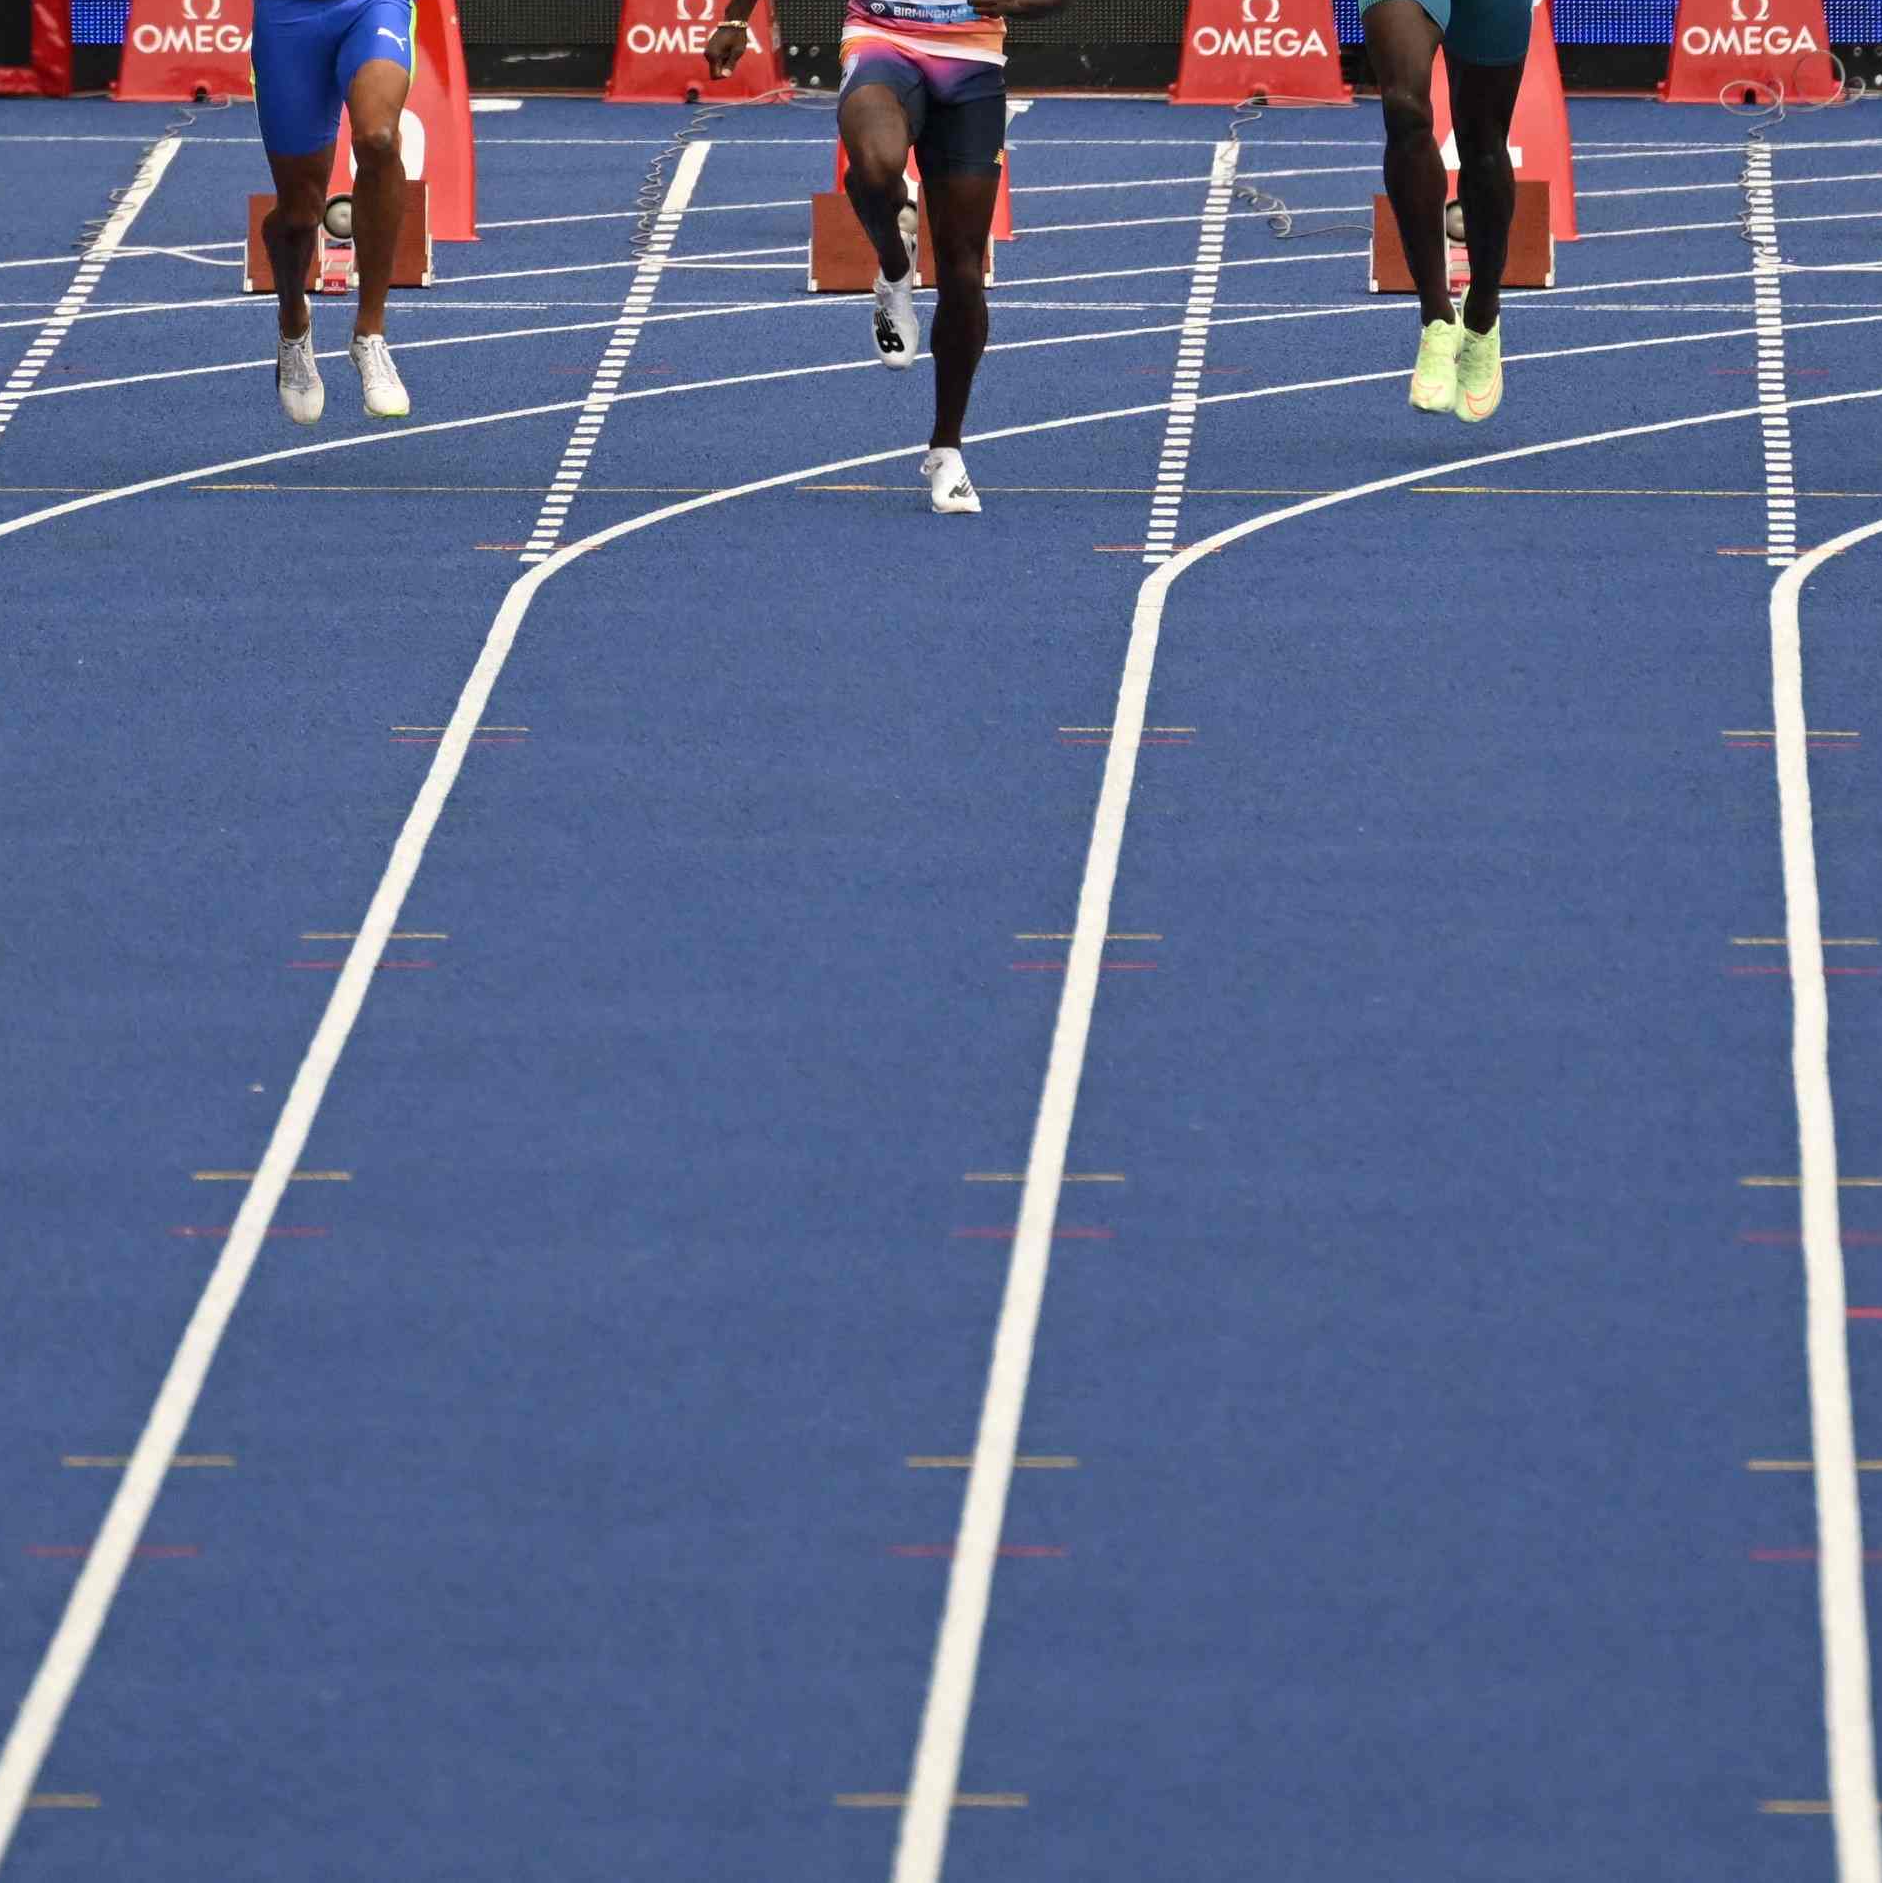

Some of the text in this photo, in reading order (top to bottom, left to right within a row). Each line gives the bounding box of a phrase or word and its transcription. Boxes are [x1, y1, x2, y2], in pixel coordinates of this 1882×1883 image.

[627, 24, 762, 54] OMEA
[1193, 26, 1328, 57] OMEGA
[1682, 25, 1817, 55] OMEGA
